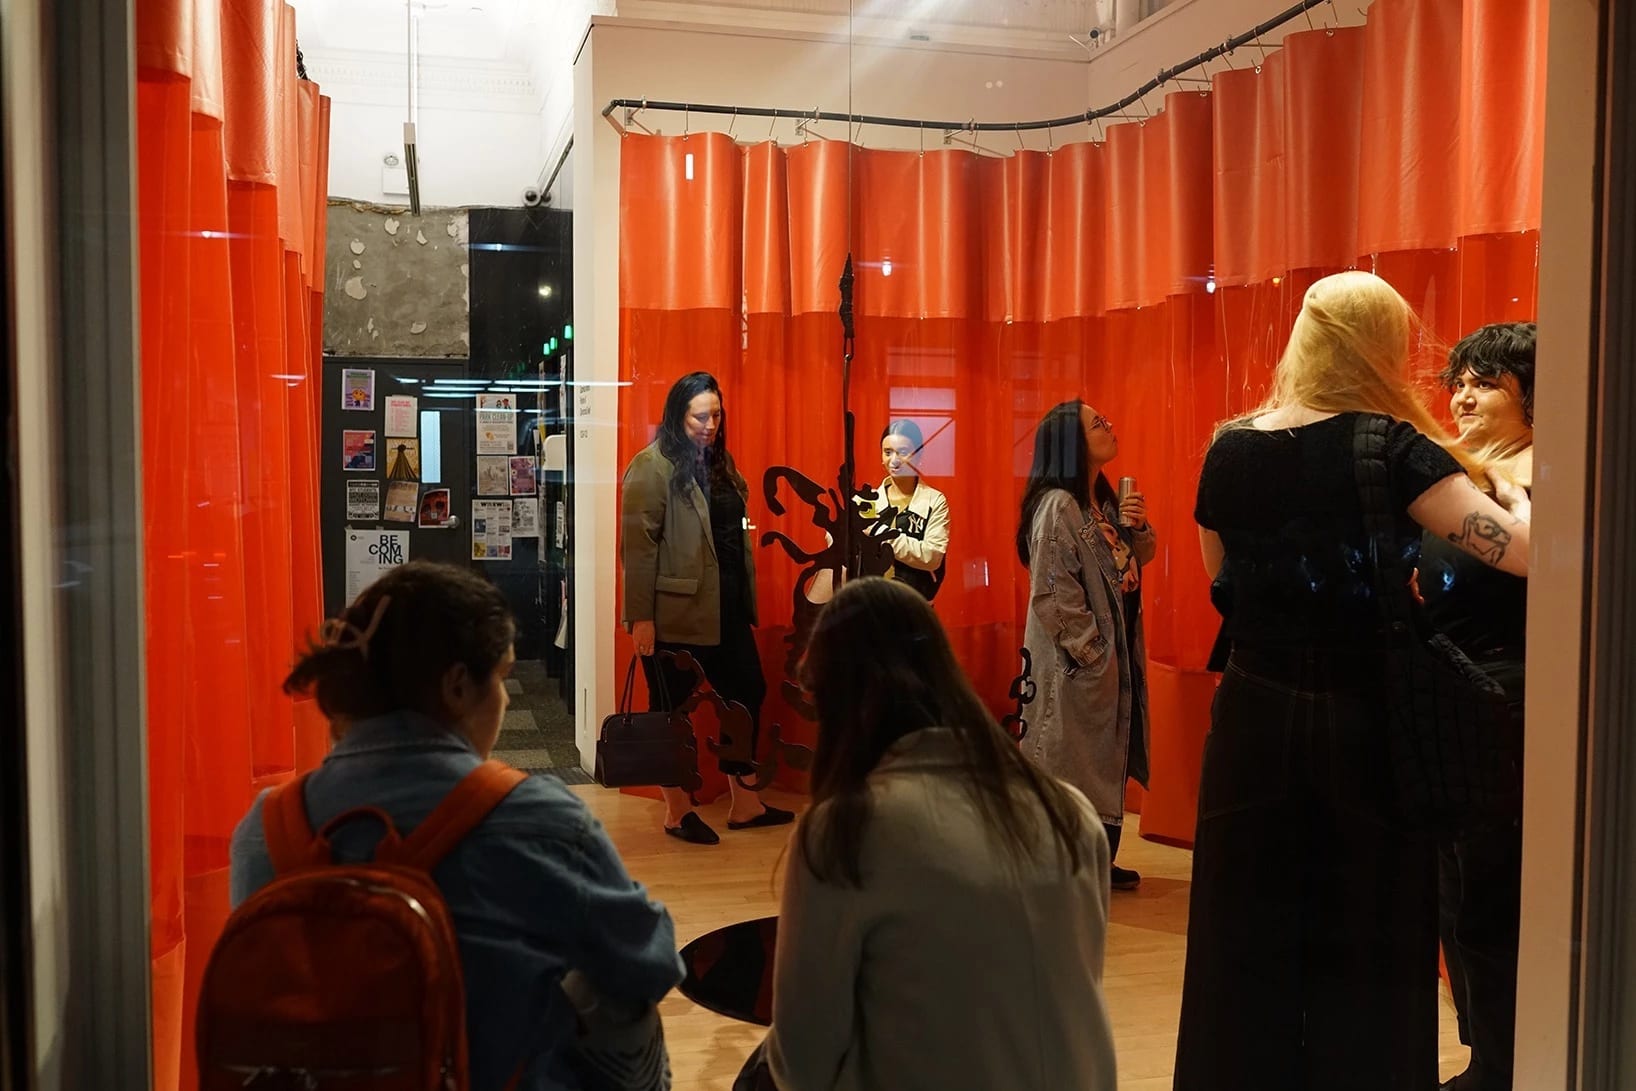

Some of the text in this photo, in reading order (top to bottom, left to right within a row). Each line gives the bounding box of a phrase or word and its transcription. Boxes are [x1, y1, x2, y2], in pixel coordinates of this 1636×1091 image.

[908, 514, 924, 533] NY
[380, 535, 398, 545] BE
[368, 544, 401, 555] COM
[378, 554, 404, 564] ING
